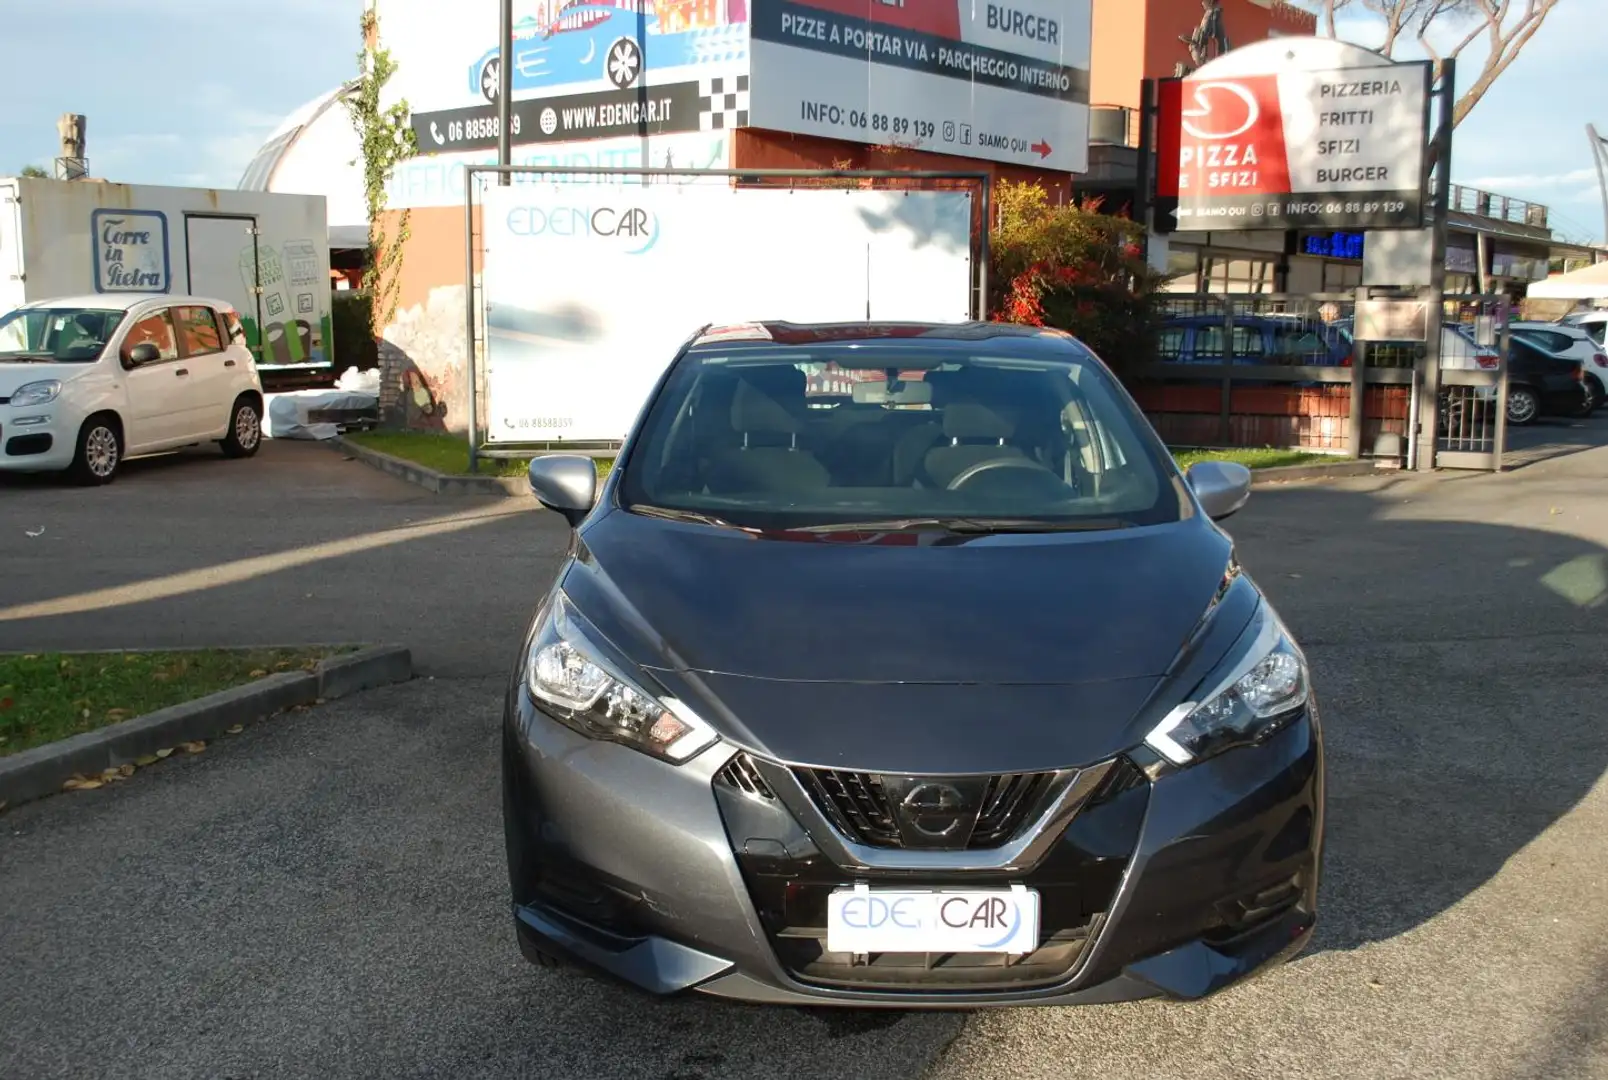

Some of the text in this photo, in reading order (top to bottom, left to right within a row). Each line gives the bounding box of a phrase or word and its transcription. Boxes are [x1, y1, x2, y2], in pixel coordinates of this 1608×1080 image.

[987, 4, 1059, 45] BURGER
[781, 13, 1070, 92] PIZZE A PORTAR VIA PARCHEGGIO INTERNO
[1320, 80, 1402, 98] PIZZERIA
[562, 98, 672, 130] WWW.EDENCAR.IT
[801, 100, 935, 138] INFO: 06 88 89 139
[1320, 110, 1374, 127] FRITTI
[448, 113, 521, 141] 06 885889
[978, 132, 1028, 153] SIAMO QUI
[1317, 139, 1361, 155] SFIZI
[1180, 143, 1258, 168] PIZZA
[1179, 171, 1258, 188] E SFIZI
[1316, 166, 1388, 183] BURGER
[1228, 205, 1246, 217] QUI
[1286, 202, 1405, 215] INFO: 06 88 89 139
[103, 218, 152, 244] Torre
[105, 245, 124, 262] in
[107, 262, 161, 287] Pietra
